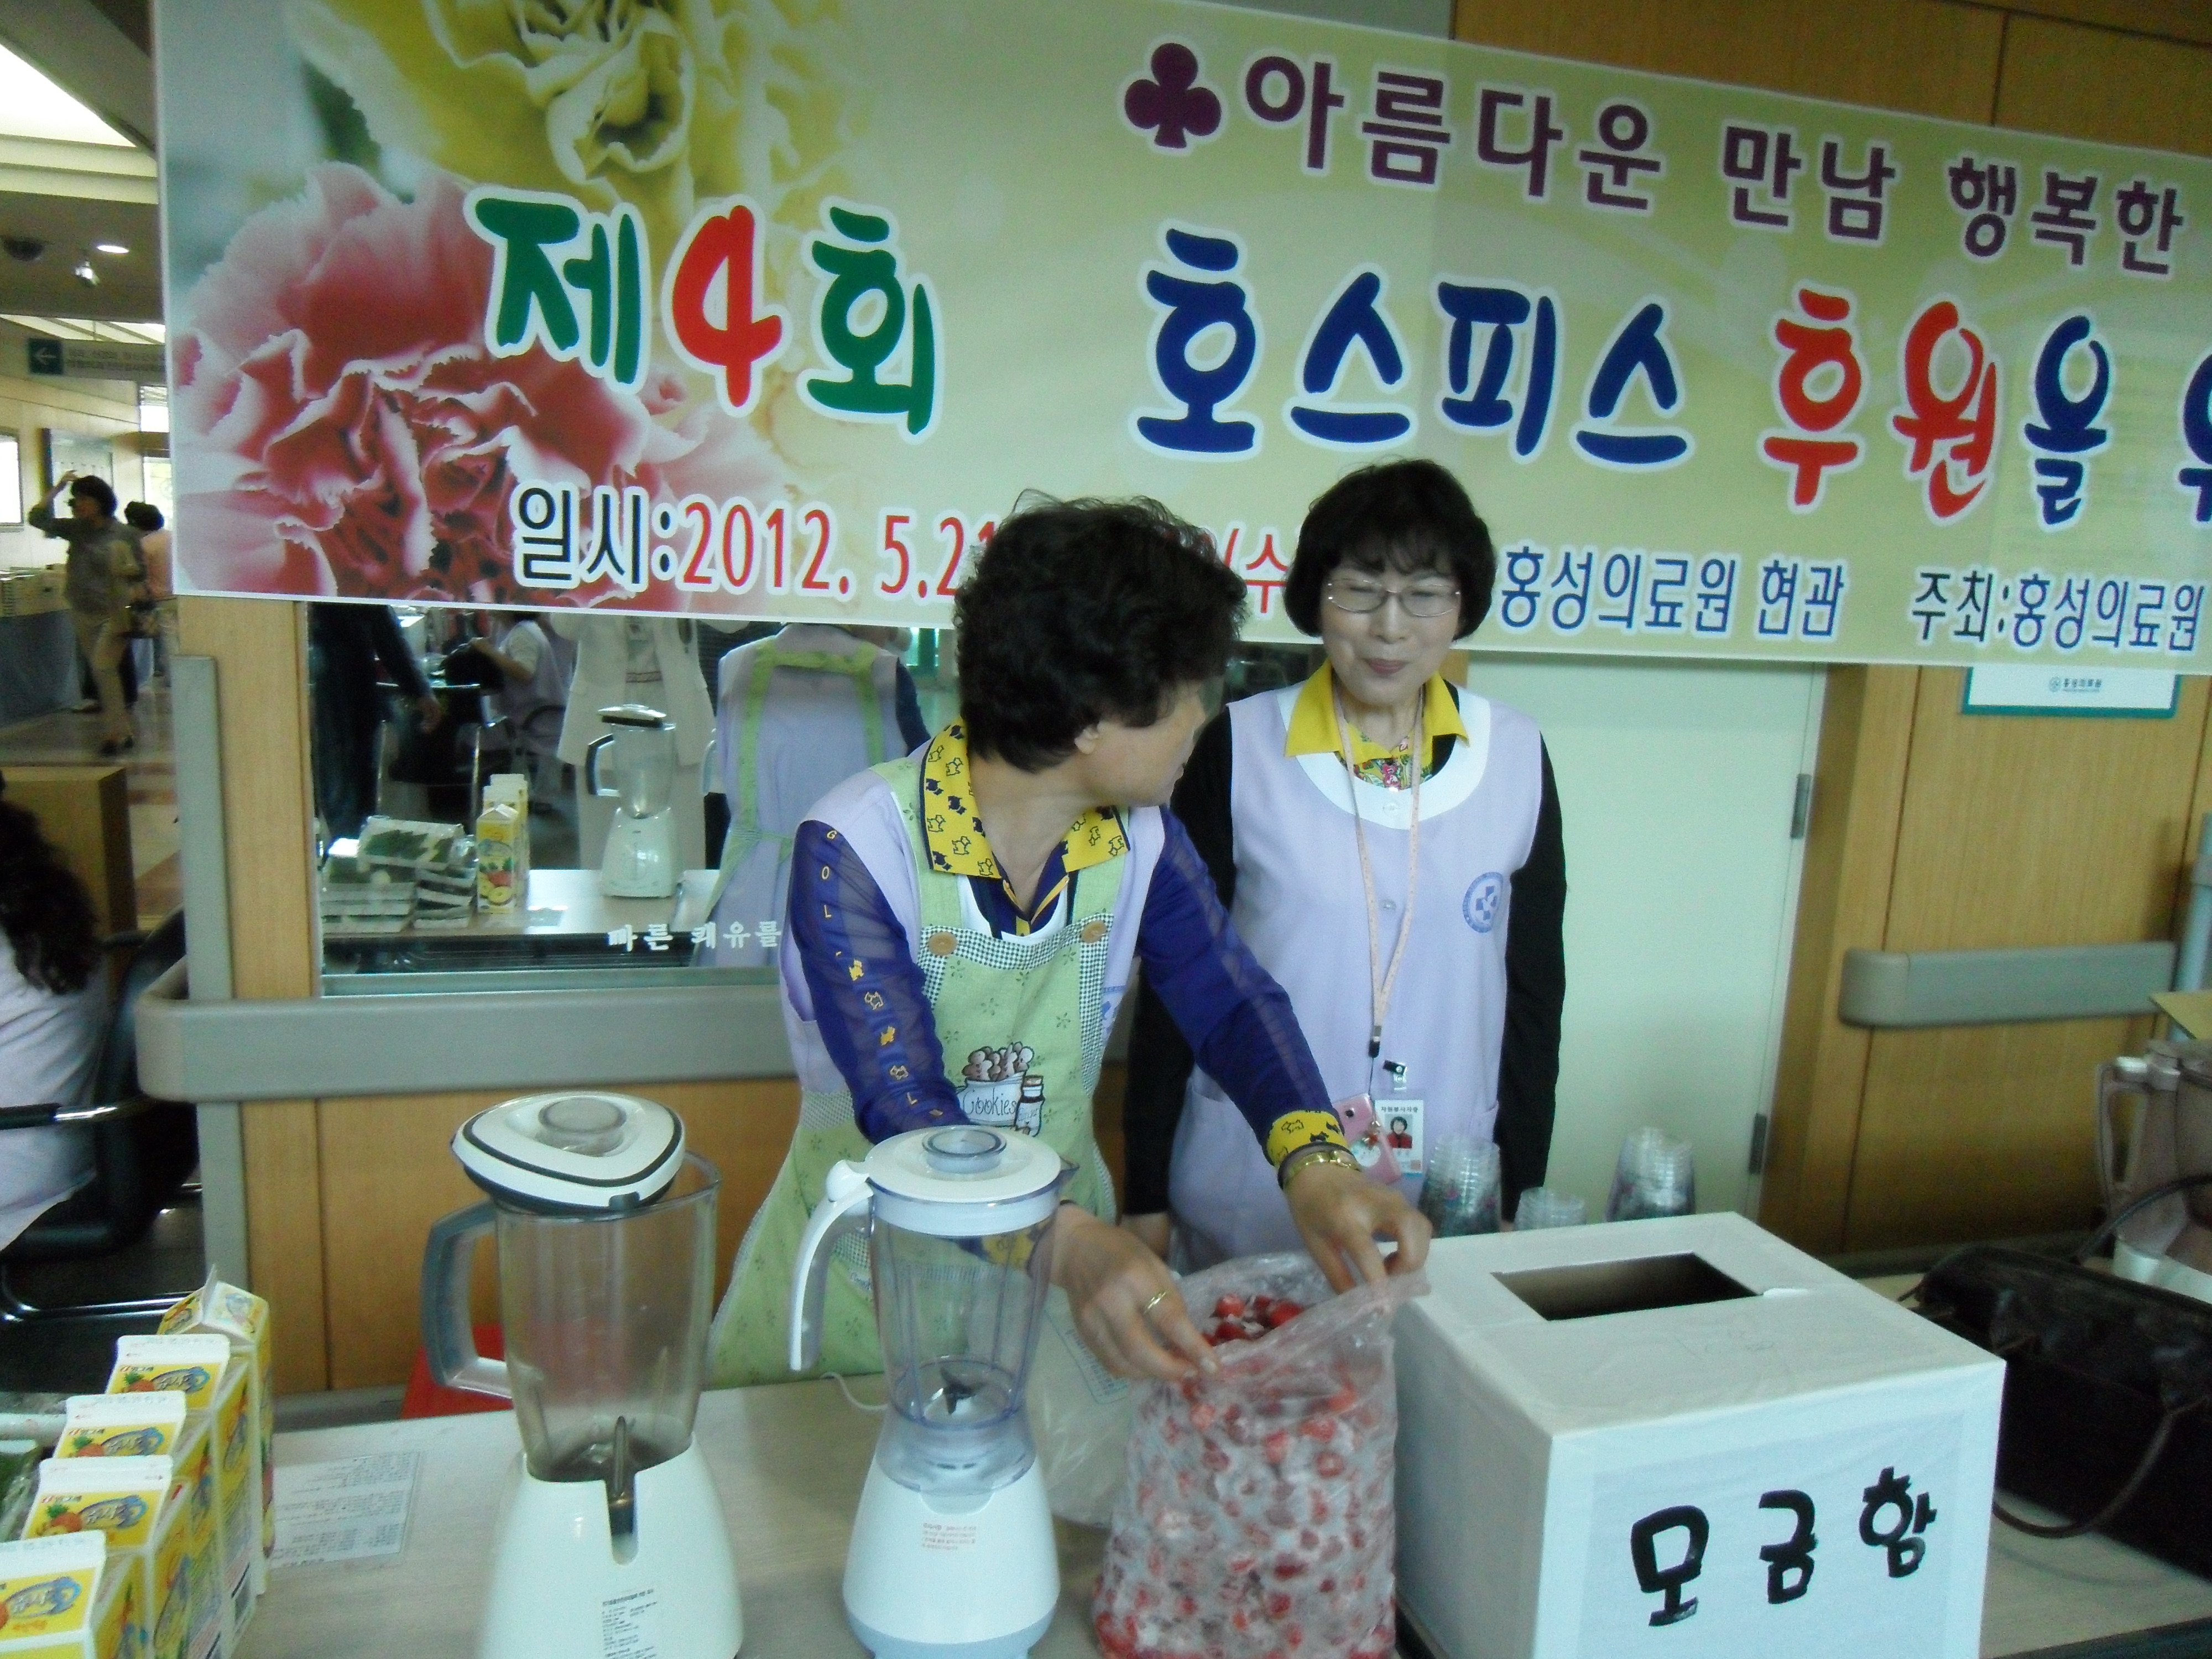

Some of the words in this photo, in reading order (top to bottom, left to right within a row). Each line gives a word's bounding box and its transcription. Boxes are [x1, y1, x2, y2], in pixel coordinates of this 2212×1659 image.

[1245, 55, 1661, 210] 아름다운
[1722, 125, 1896, 240] 만남
[1948, 156, 2184, 275] 행복한
[474, 197, 936, 436] 제4회
[1136, 227, 1688, 465] 호스피스
[1763, 288, 2110, 525] 후원을
[1501, 546, 1736, 633] 홍성의료원
[1759, 559, 1844, 638] 현관
[607, 924, 674, 952] 빠른
[691, 920, 782, 950] 쾌유를
[963, 1087, 1017, 1116] Cookies
[1630, 1465, 1937, 1627] 모금함
